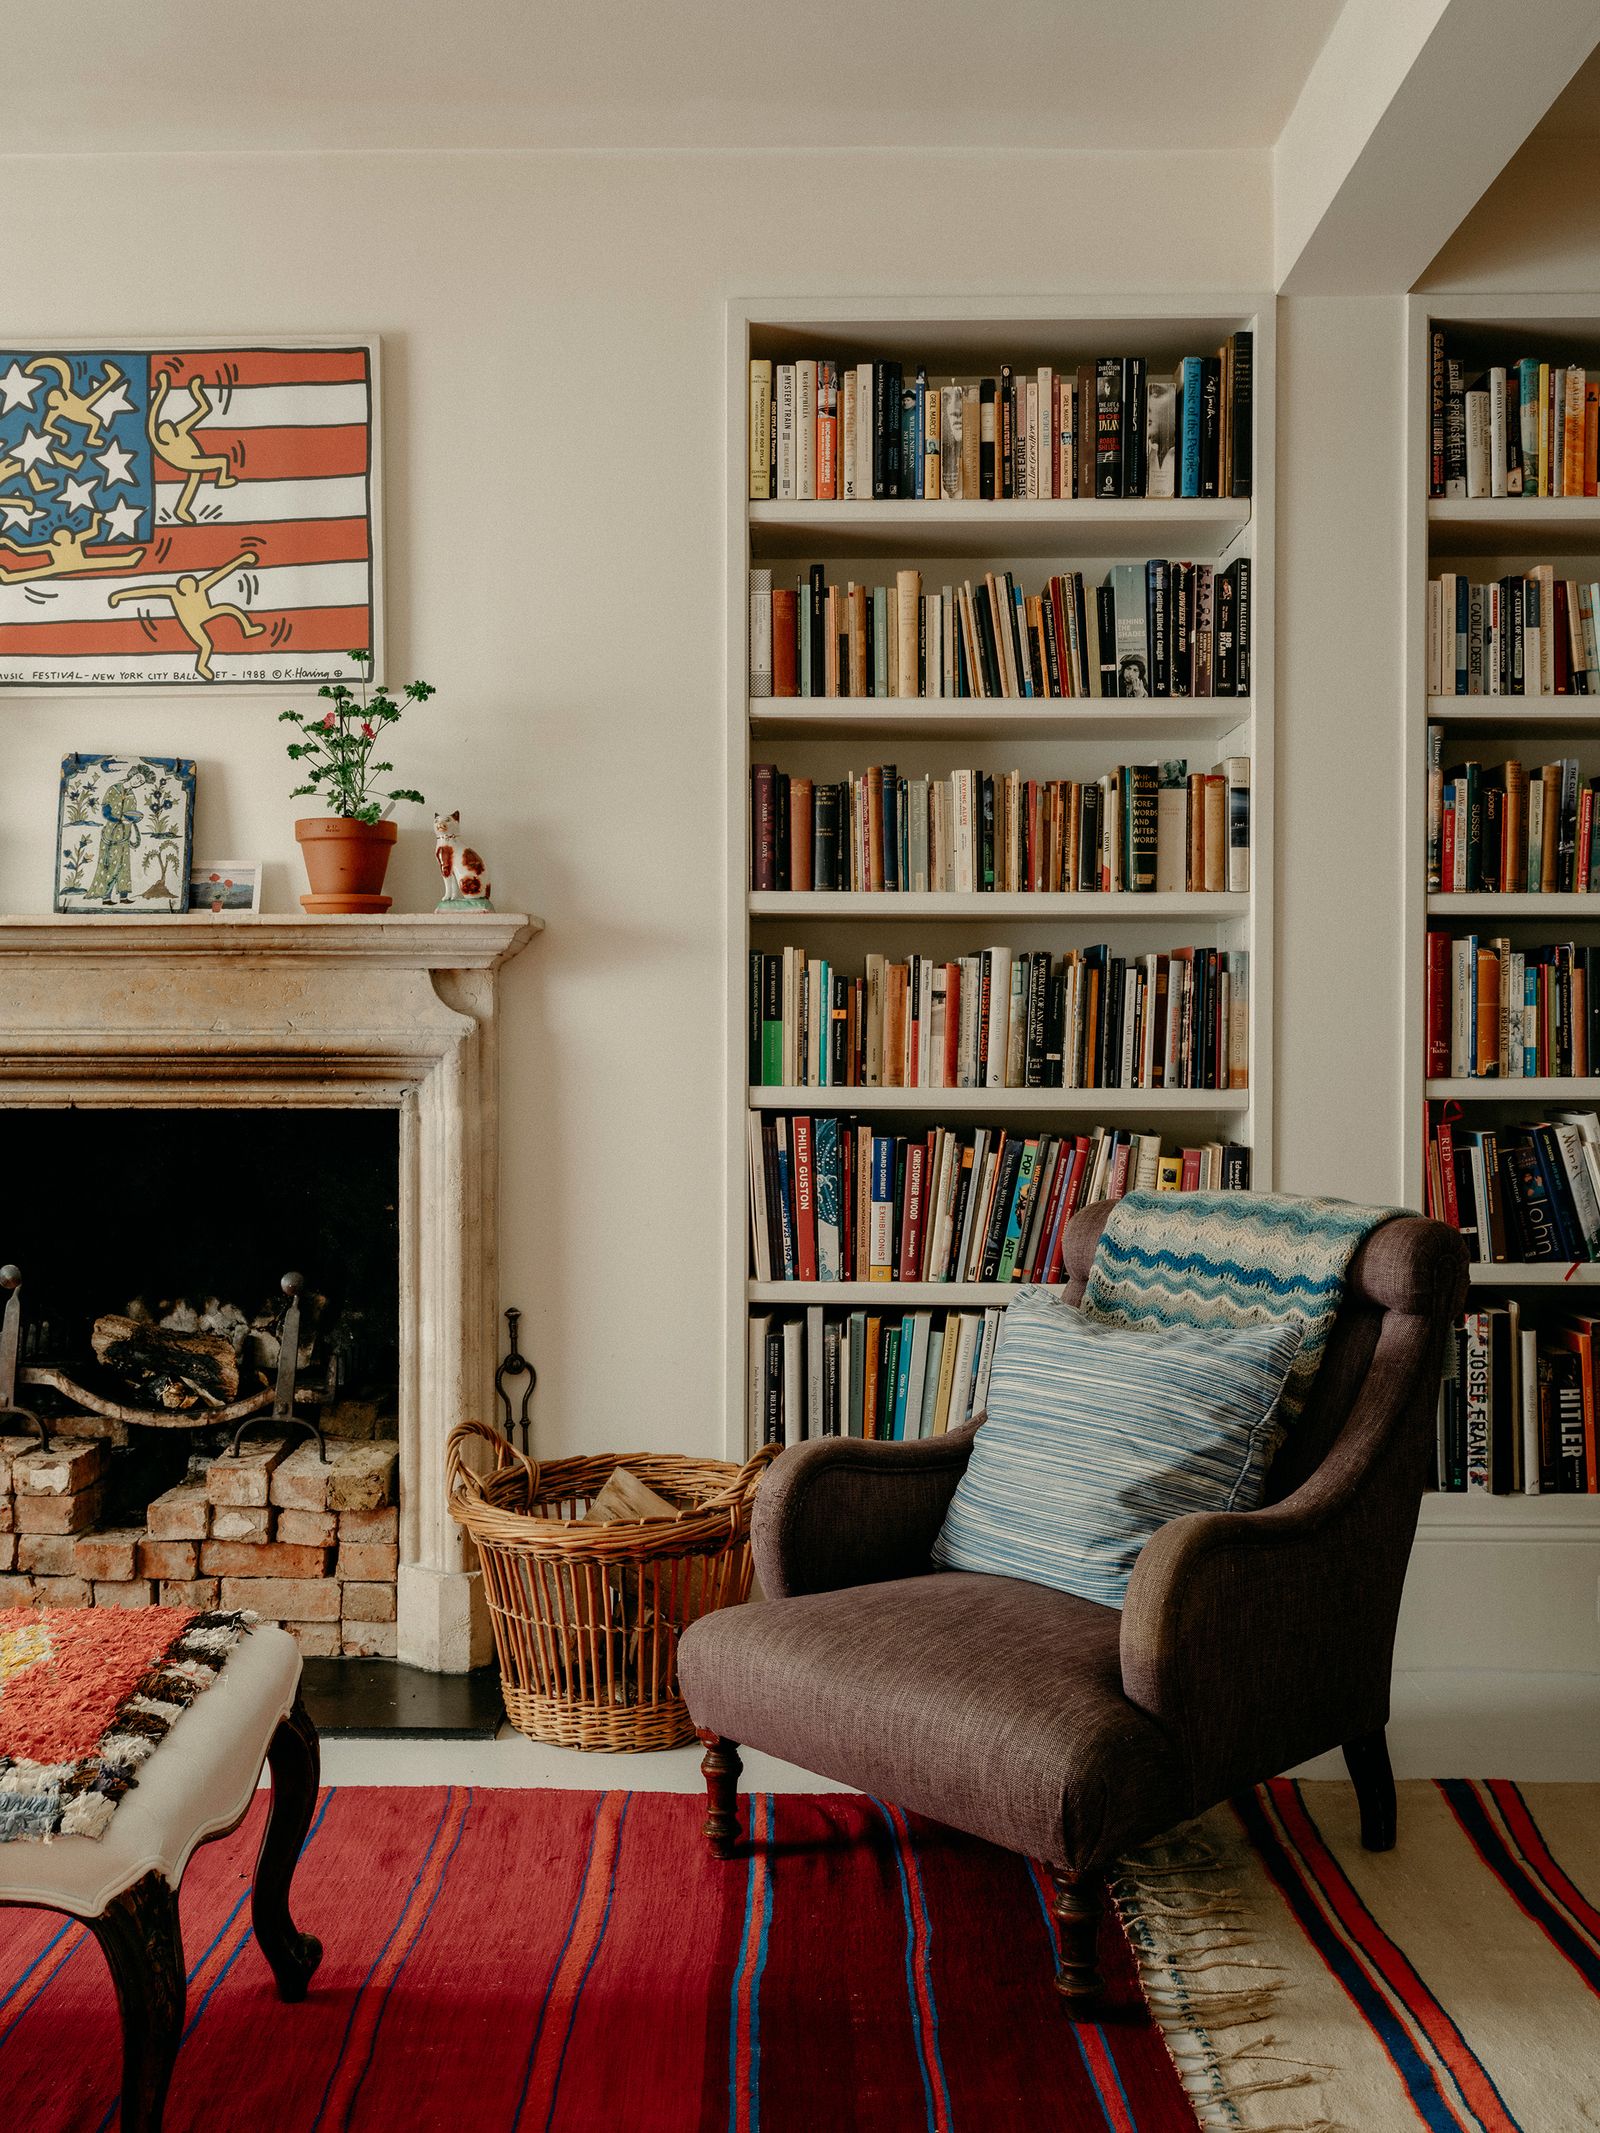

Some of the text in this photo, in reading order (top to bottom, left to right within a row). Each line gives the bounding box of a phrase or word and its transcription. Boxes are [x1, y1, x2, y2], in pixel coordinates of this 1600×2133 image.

[1434, 333, 1444, 411] GARCIA
[801, 372, 809, 418] MUSICOPHILIA
[1098, 420, 1120, 431] DYLAN
[1186, 372, 1199, 473] Music of the People
[1450, 365, 1462, 461] BRUCE SPRINGSTEEN
[904, 431, 908, 440] MY
[1017, 436, 1026, 465] EARLE
[1017, 468, 1026, 496] STEVE
[1156, 567, 1164, 589] Without
[1156, 591, 1164, 612] Getting
[1180, 627, 1186, 635] TO
[1471, 603, 1482, 676] CADILLAC DESERT
[32, 671, 83, 680] FESTIVAL
[120, 672, 144, 680] YORK
[148, 672, 168, 680] CITY
[242, 670, 266, 680] 1988
[1471, 804, 1480, 844] SUSSEX
[1501, 940, 1510, 976] IRELAND
[982, 977, 991, 1014] MATISSE
[1038, 998, 1044, 1008] OF
[1038, 1010, 1043, 1020] AN
[1501, 1007, 1509, 1035] ROBERT
[980, 1024, 988, 1061] PICASSO
[1235, 1032, 1244, 1063] Bloom
[1007, 1153, 1015, 1164] THE
[1442, 1137, 1451, 1161] RED
[1563, 1134, 1584, 1182] Monet
[798, 1128, 810, 1209] PHILIP GUSTON
[1021, 1154, 1033, 1174] POP
[1116, 1151, 1127, 1187] PICASSO:
[910, 1149, 922, 1219] CHRISTOPHER WOOD
[1507, 1156, 1522, 1203] Naked Portrait
[1000, 1189, 1009, 1205] MYTH
[997, 1206, 1006, 1219] AND
[993, 1221, 1004, 1239] IMAGE
[1004, 1239, 1015, 1259] ART
[770, 1416, 777, 1425] AT
[1470, 1350, 1487, 1468] JOSEF FRANK
[1560, 1388, 1583, 1457] HITLER
